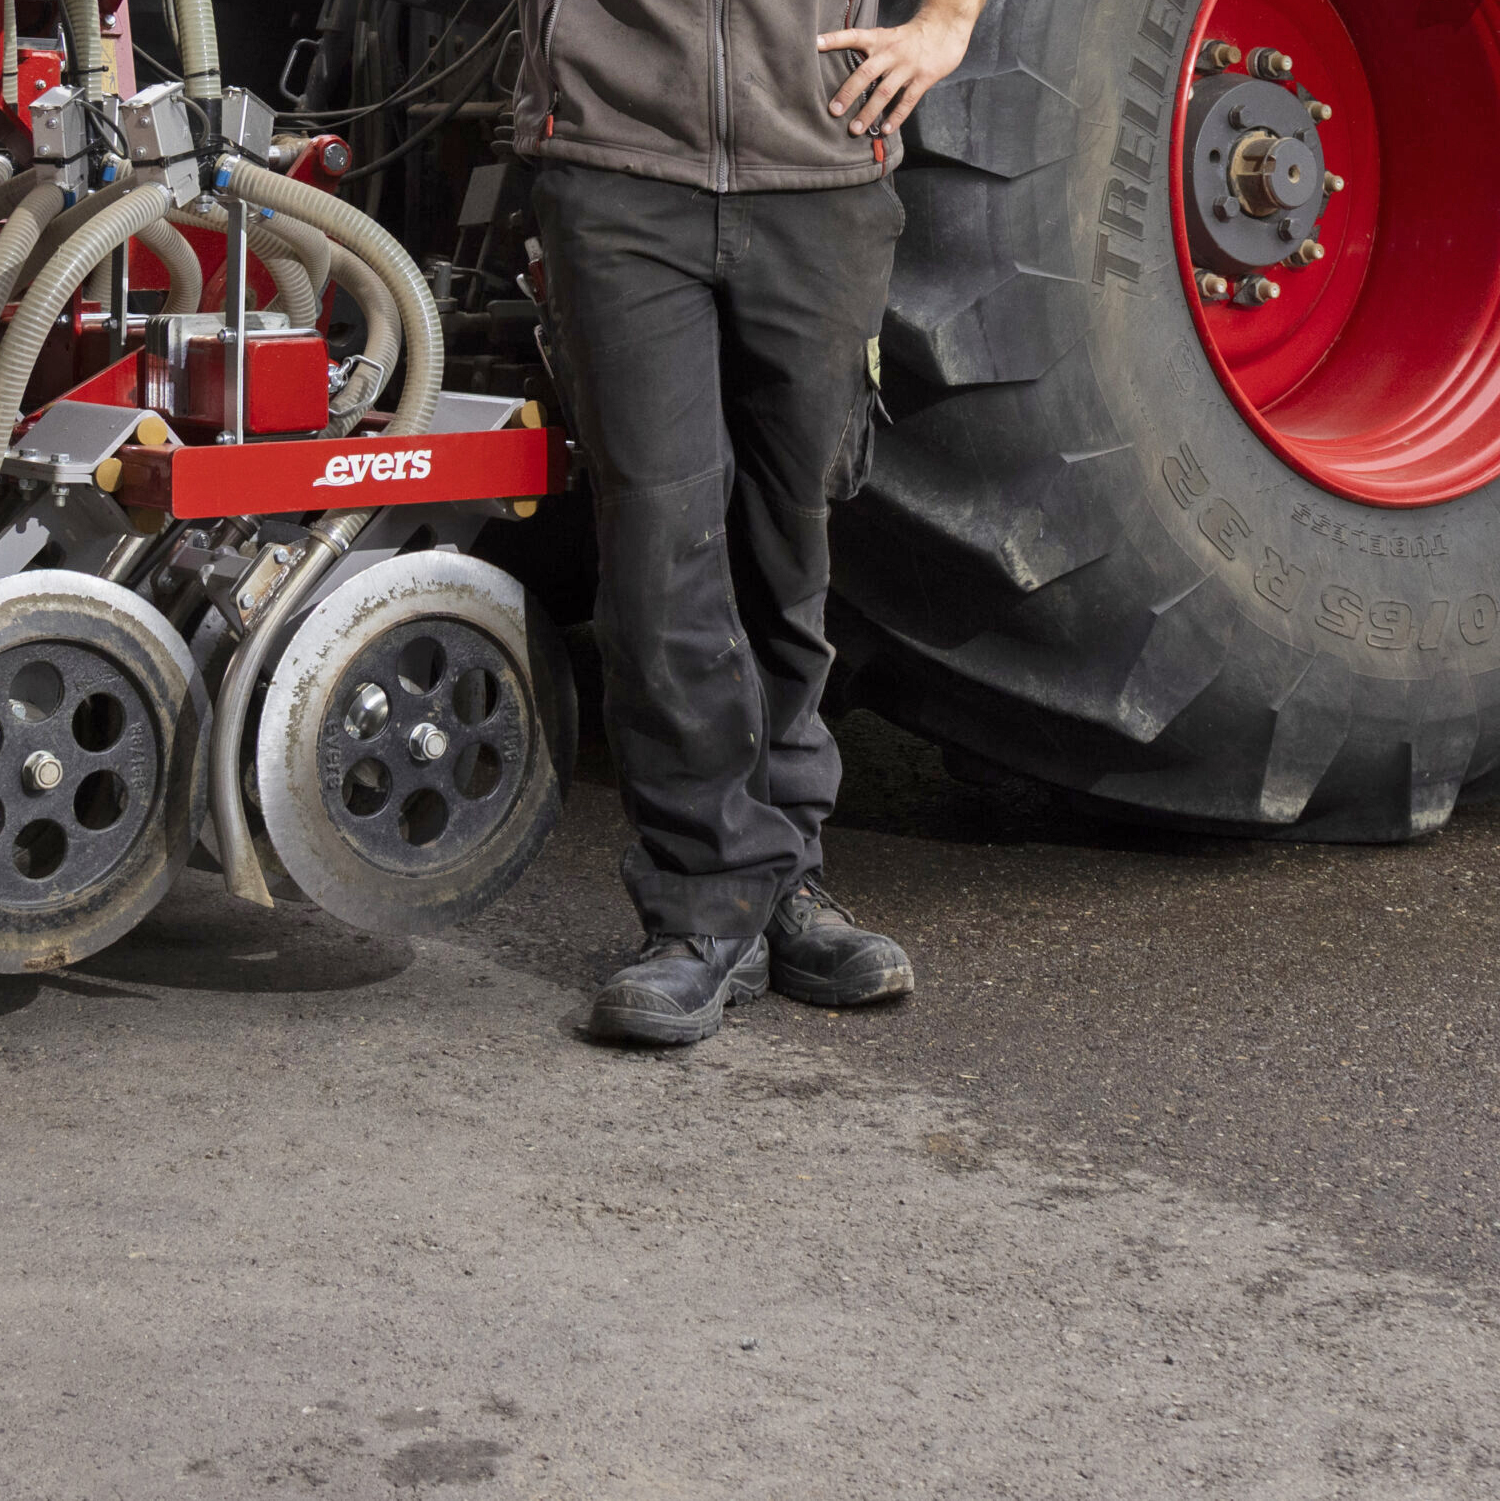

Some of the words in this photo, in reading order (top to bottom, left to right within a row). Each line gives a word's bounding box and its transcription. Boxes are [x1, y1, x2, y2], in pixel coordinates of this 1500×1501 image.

[324, 449, 432, 483] evers
[1161, 442, 1253, 562] 32
[1291, 501, 1452, 559] TUBELESS
[1253, 545, 1306, 614] R
